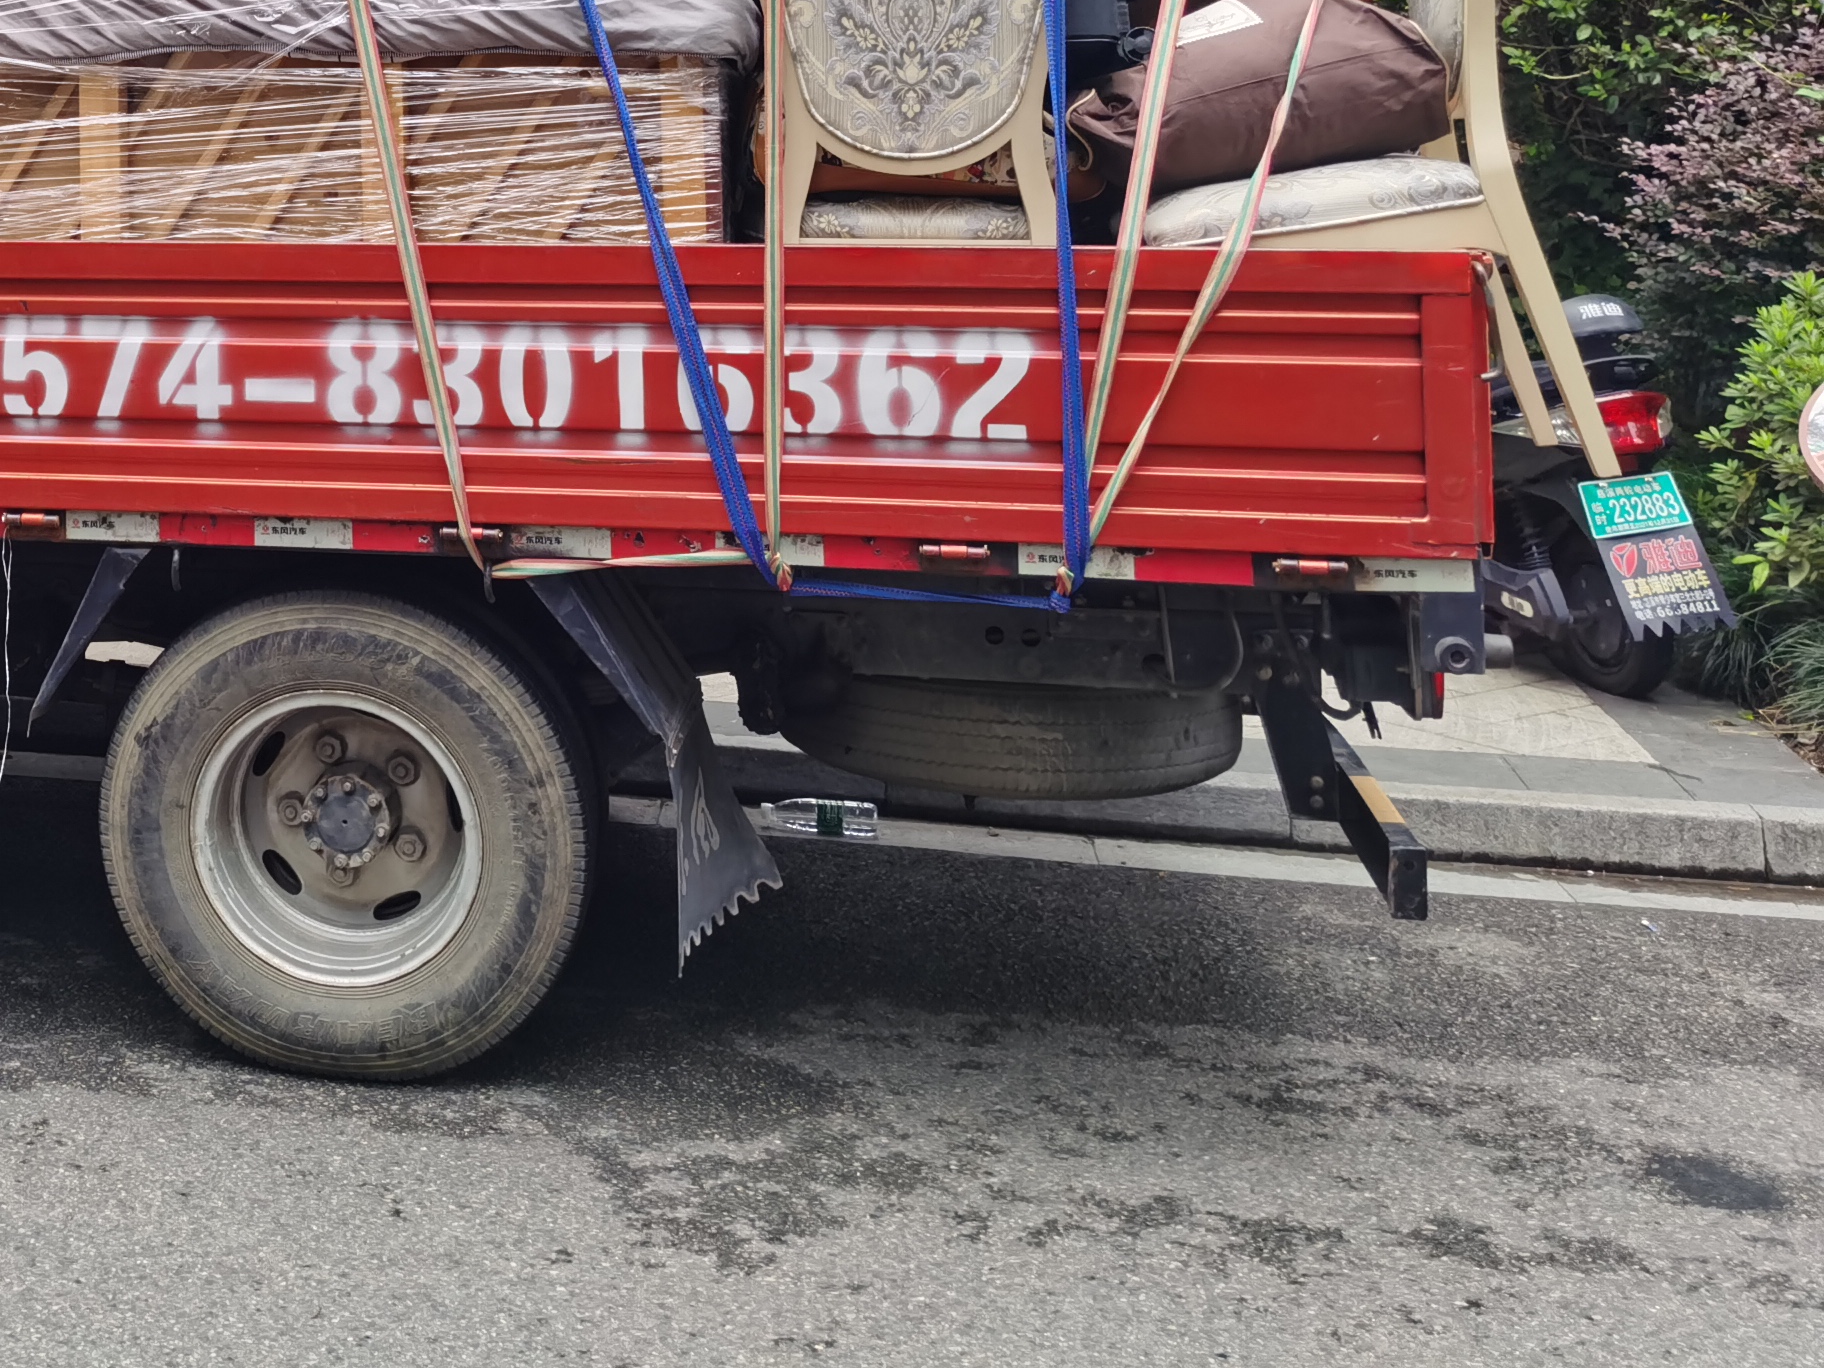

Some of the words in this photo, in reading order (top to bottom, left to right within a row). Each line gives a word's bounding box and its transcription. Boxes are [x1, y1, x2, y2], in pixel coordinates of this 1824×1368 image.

[1578, 302, 1624, 319] 雅迪
[271, 526, 307, 536] 东风汽车
[526, 535, 563, 545] 东风汽车
[1639, 535, 1702, 574] 雅迪
[1373, 569, 1418, 579] 东风汽车
[1622, 569, 1711, 599] 更高端的电动车
